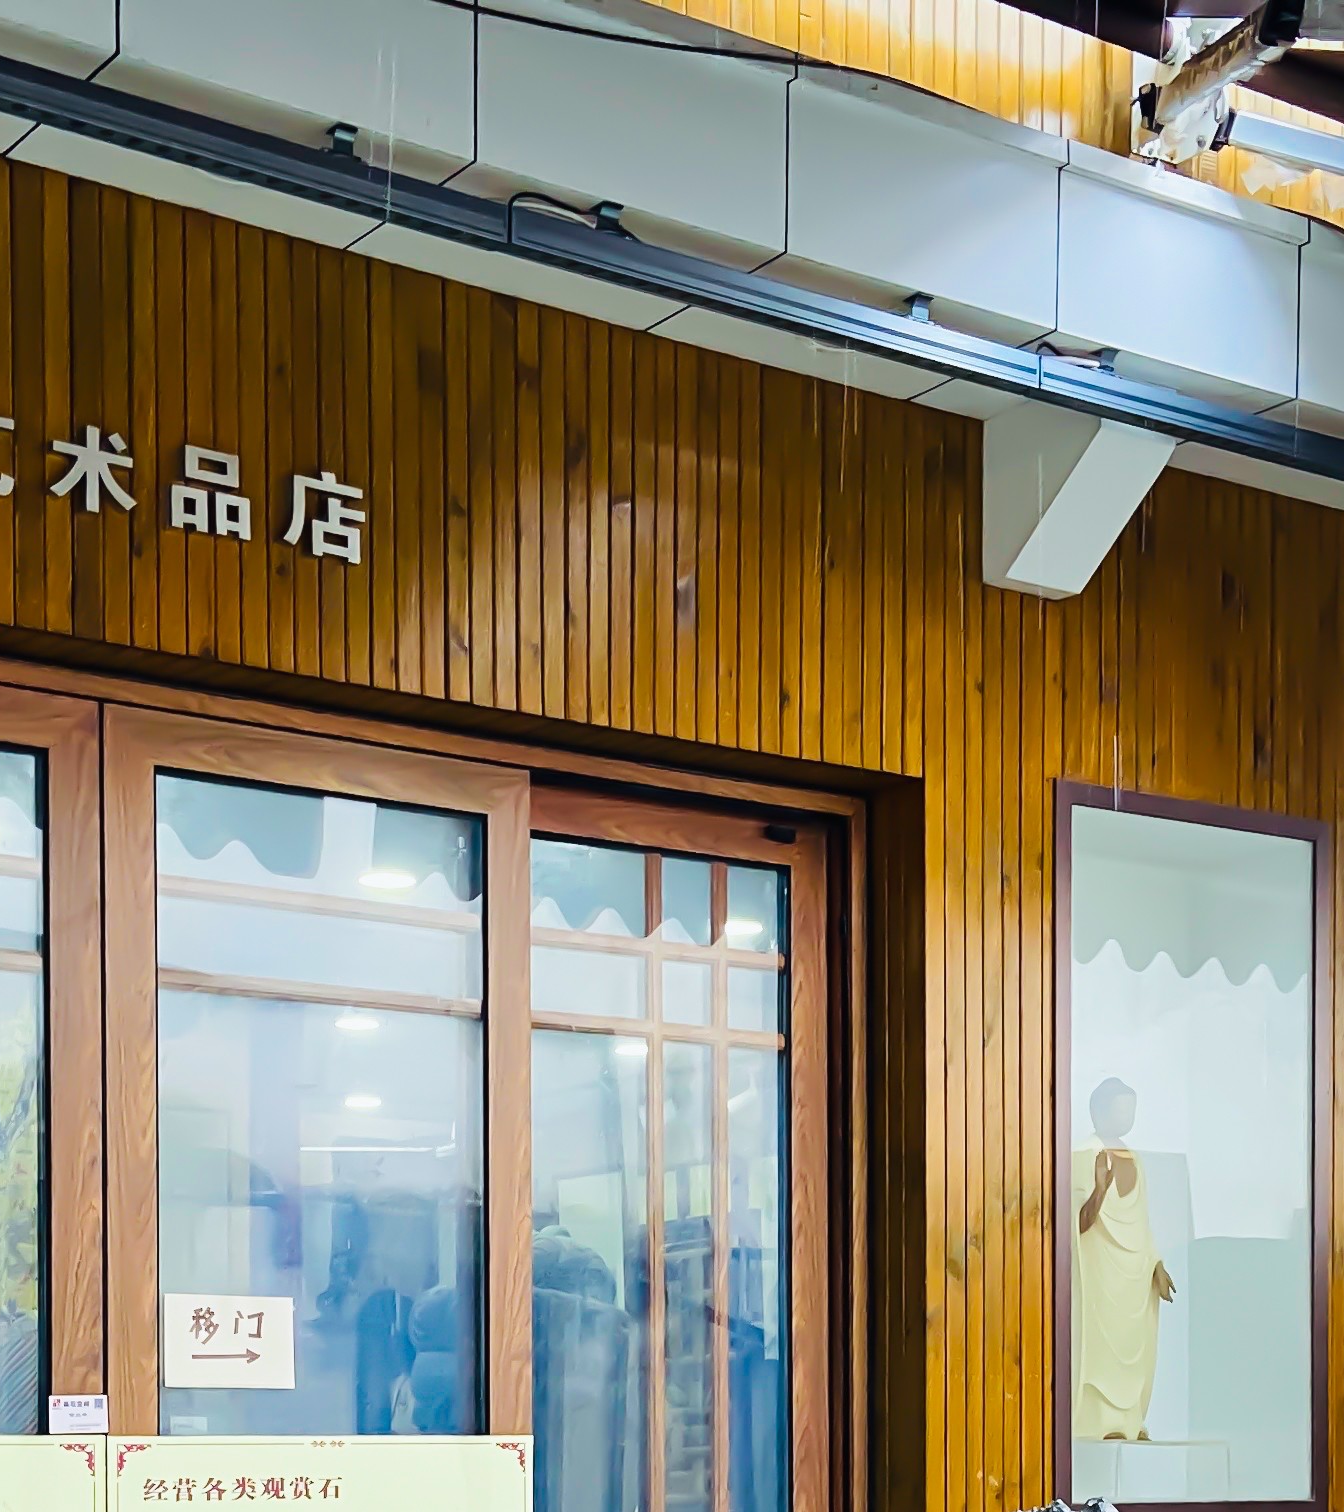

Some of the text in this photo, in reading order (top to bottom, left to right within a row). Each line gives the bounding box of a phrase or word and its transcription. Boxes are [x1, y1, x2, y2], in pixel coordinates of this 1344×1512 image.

[189, 1306, 265, 1345] 移门
[143, 1476, 343, 1502] 经营各类观赏石
